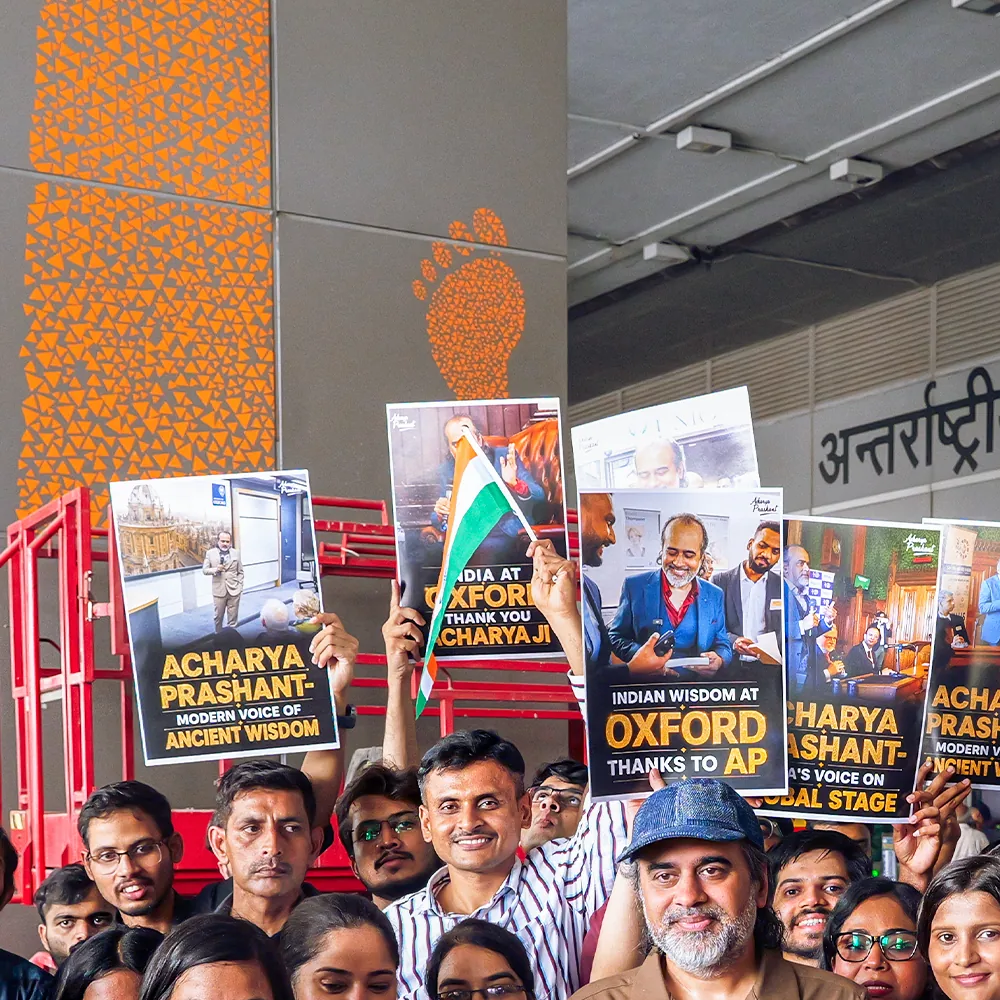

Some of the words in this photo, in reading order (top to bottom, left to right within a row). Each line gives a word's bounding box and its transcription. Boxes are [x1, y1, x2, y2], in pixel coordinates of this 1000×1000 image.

[457, 568, 495, 583] NDIA
[500, 567, 521, 581] AT
[444, 611, 497, 625] THANK
[499, 610, 531, 622] YOU
[532, 624, 551, 644] JI
[161, 644, 305, 680] ACHARYA
[159, 674, 314, 709] PRASHANT-
[612, 689, 666, 705] INDIAN
[669, 688, 736, 703] WISDOM
[739, 688, 760, 701] AT
[176, 709, 236, 726] MODERN
[239, 706, 280, 721] VOICE
[283, 704, 302, 717] OF
[165, 725, 241, 750] ANCIENT
[243, 719, 320, 743] WISDOM
[605, 709, 767, 749] OXFORD
[787, 733, 907, 766] ASHANT-
[936, 742, 989, 755] MODERN
[607, 756, 686, 777] THANKS
[690, 755, 718, 772] TO
[723, 747, 768, 775] AP
[814, 769, 859, 785] VOICE
[862, 773, 885, 787] ON
[828, 790, 898, 813] STAGE
